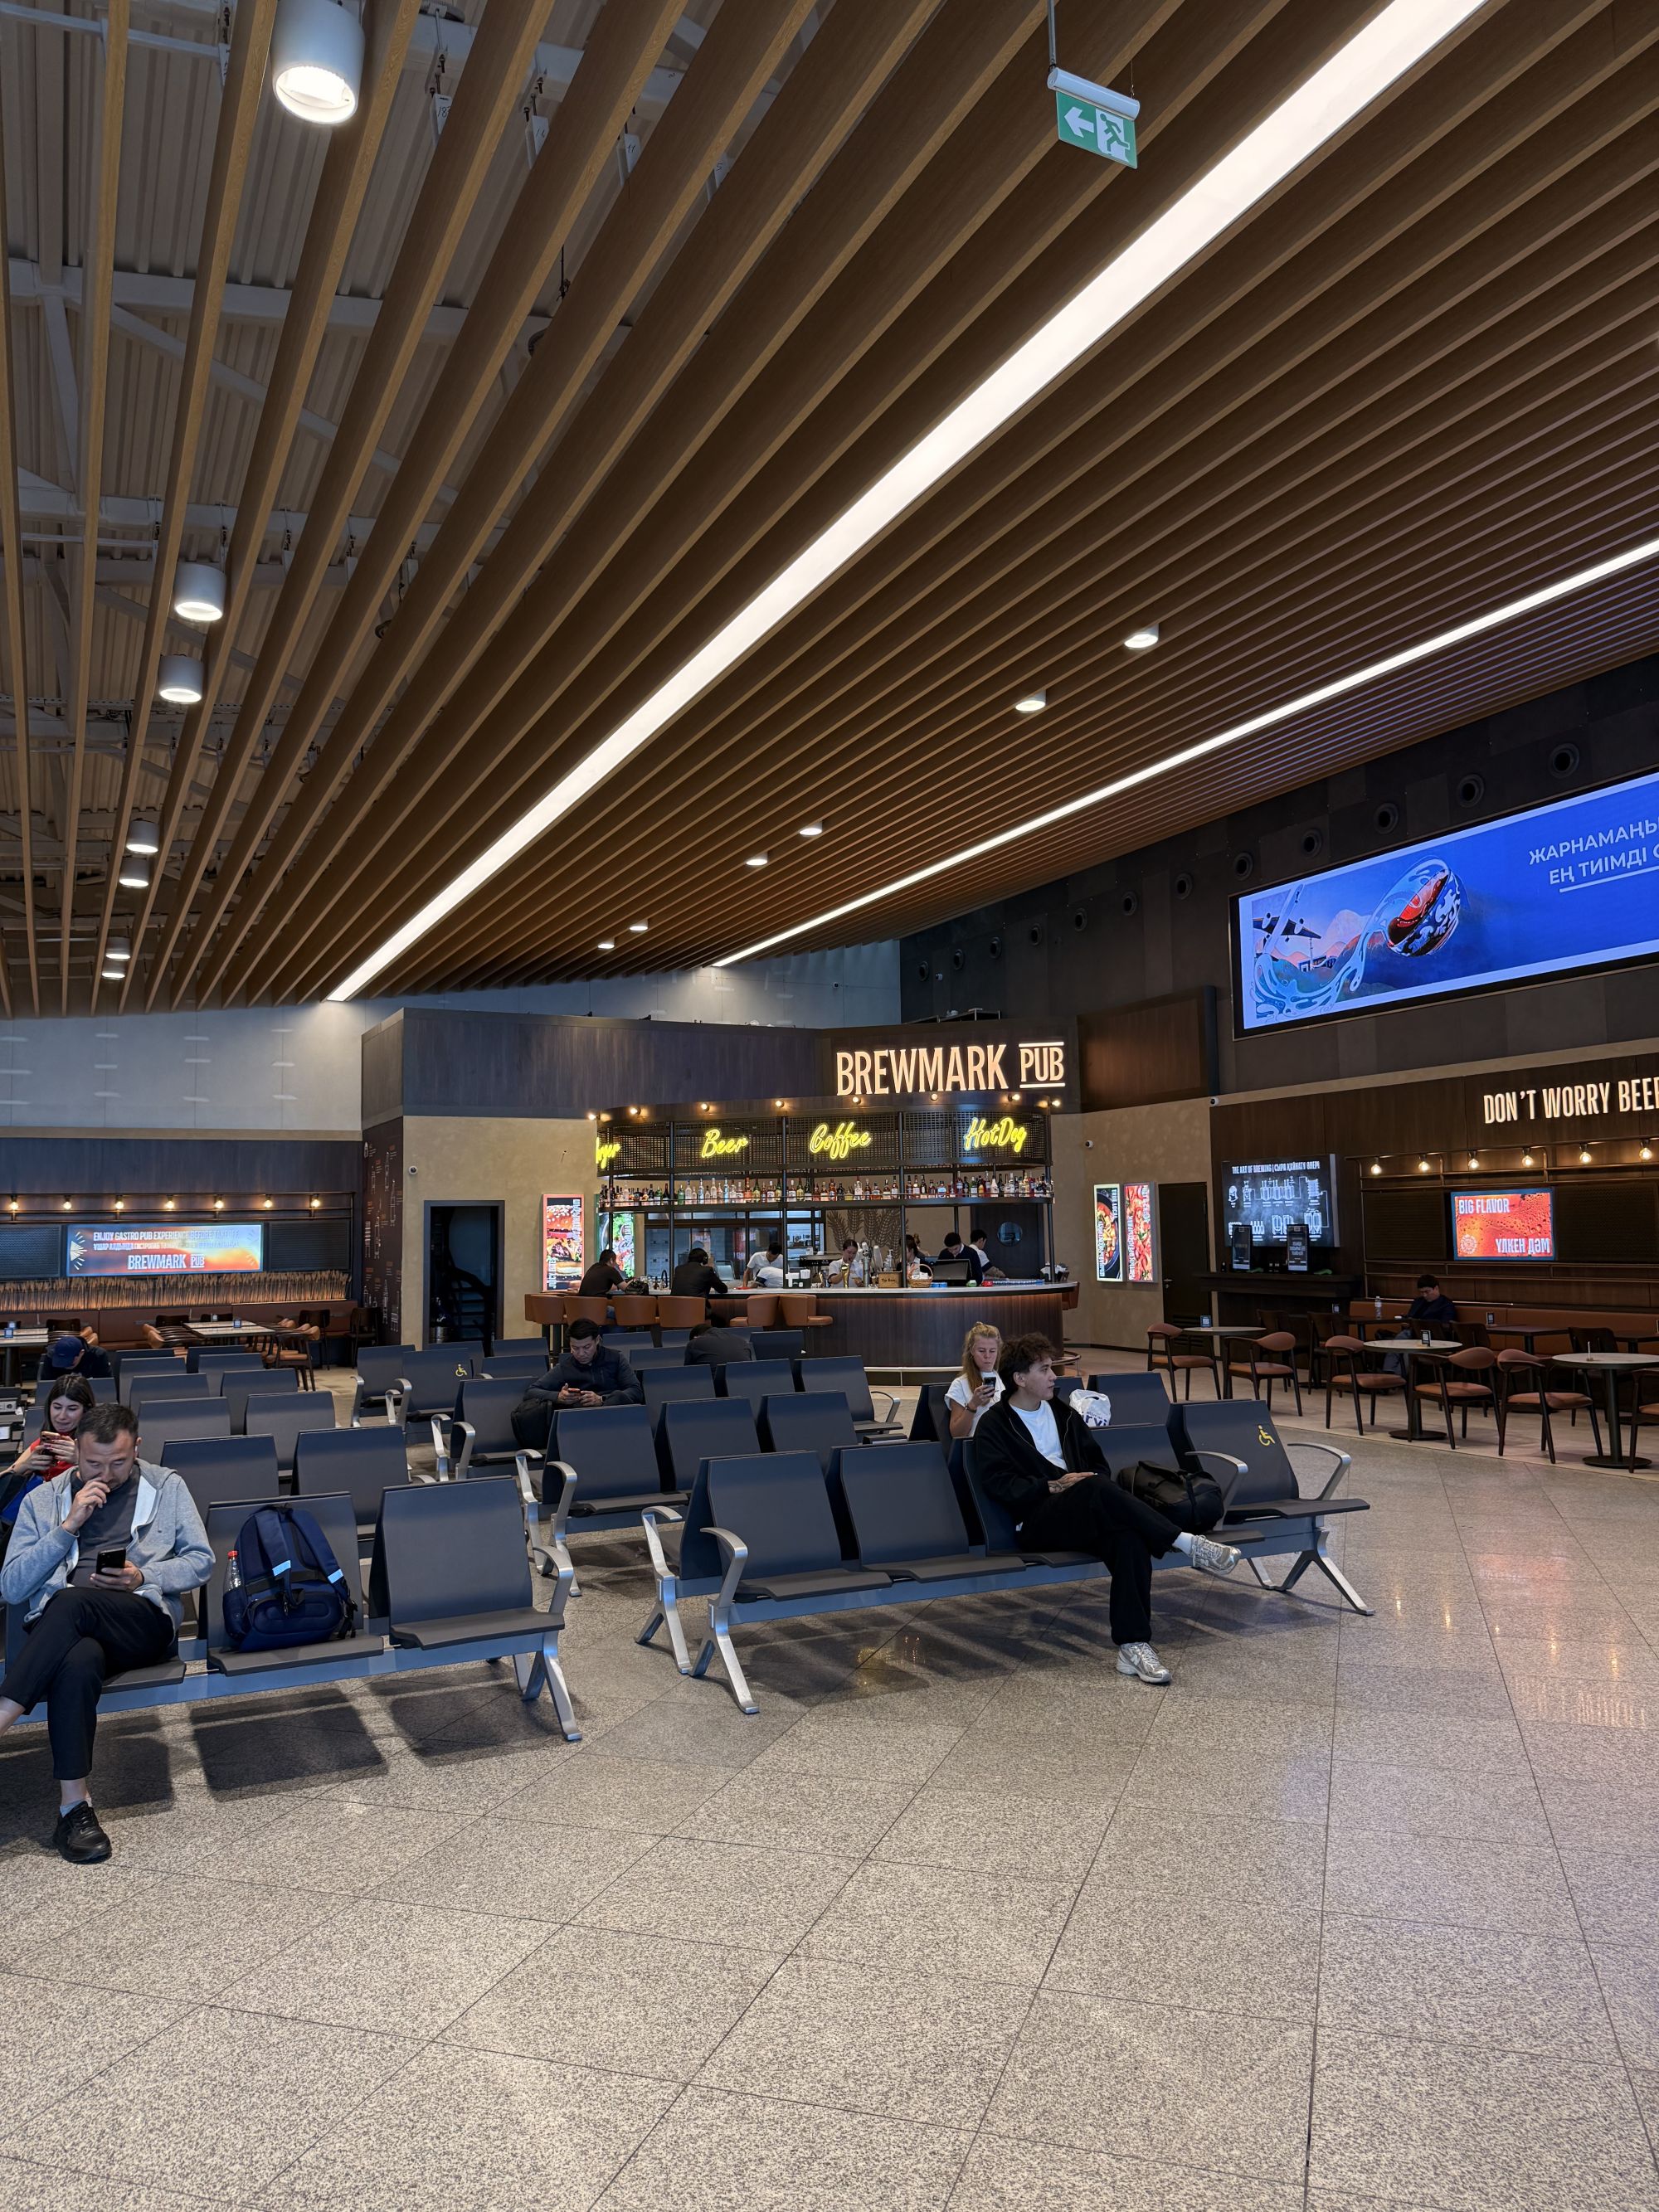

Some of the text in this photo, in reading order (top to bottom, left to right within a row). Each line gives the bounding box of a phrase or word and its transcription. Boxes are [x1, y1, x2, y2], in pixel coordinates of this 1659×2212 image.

[1550, 866, 1575, 885] ЕҢ
[1578, 847, 1647, 878] ТИІМДІ
[836, 1044, 1064, 1096] BREWMARK PUB
[1542, 1082, 1610, 1119] WORRY
[701, 1129, 748, 1159] Beer
[810, 1121, 872, 1159] Coffee
[1458, 1198, 1510, 1214] BIG FLAVOR
[93, 1232, 114, 1242] ENJOY
[114, 1231, 139, 1241] GASTRO
[139, 1231, 153, 1240] PUB
[1527, 1237, 1550, 1255] ДӘМ
[128, 1254, 205, 1270] BREWMARK PUB
